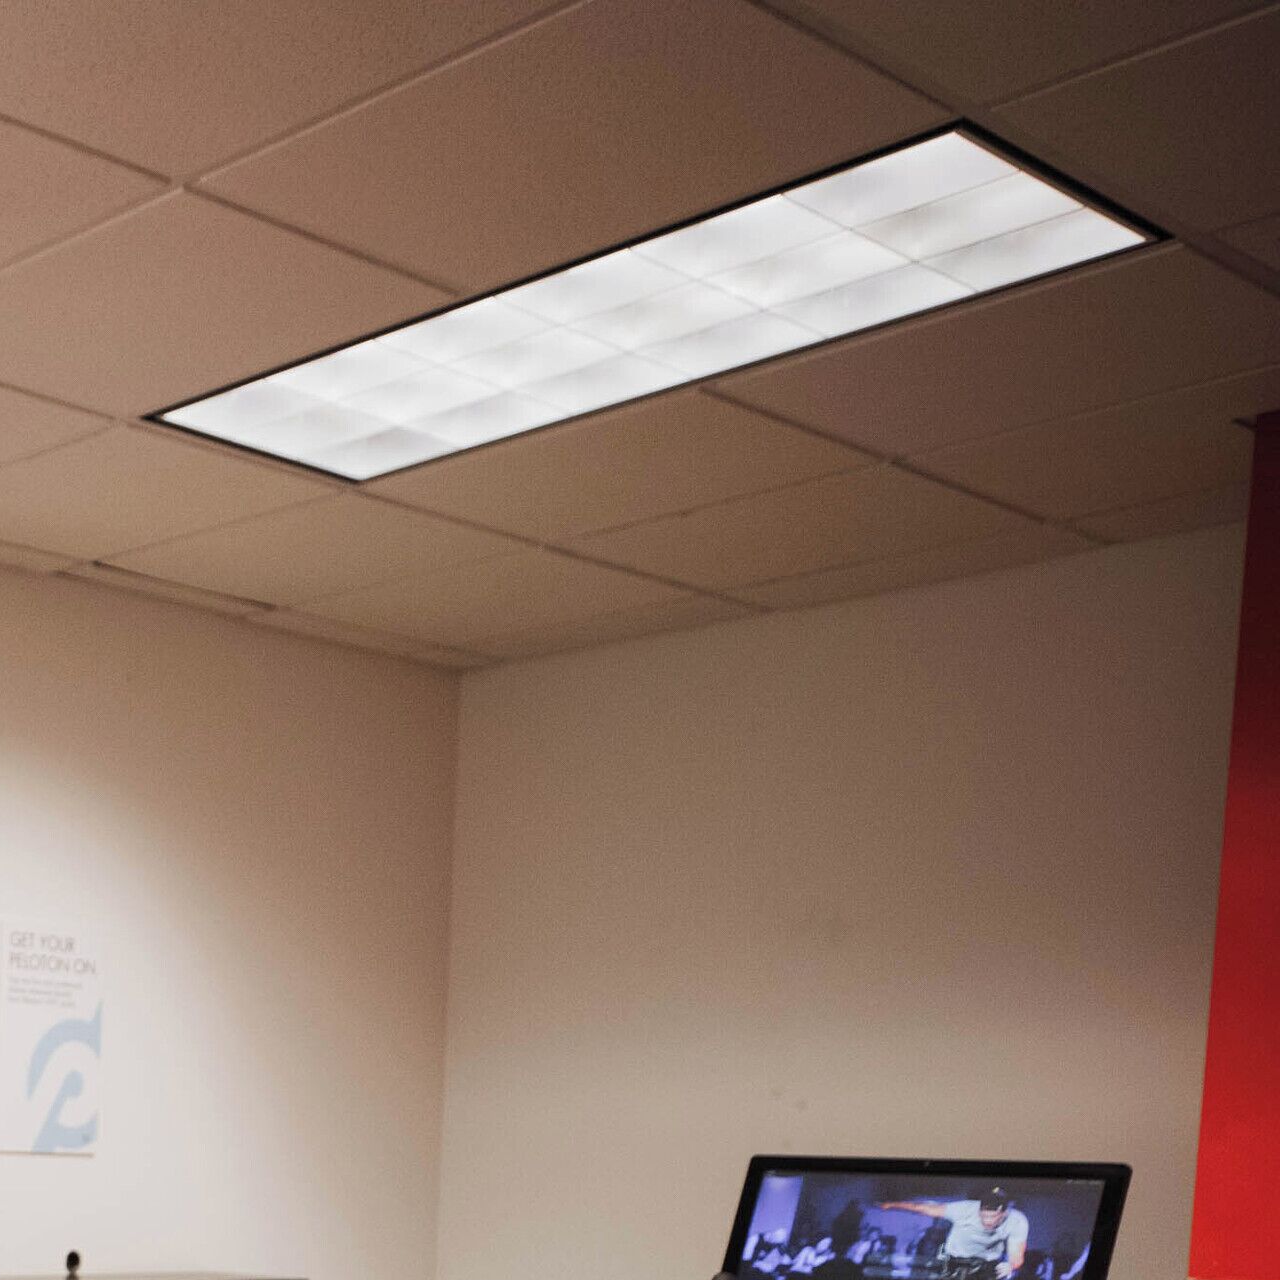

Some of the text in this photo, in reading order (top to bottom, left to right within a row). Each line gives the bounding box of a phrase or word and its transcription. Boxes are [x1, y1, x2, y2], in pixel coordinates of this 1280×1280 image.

[10, 931, 75, 953] GET YOUR
[9, 951, 71, 975] PELOTON
